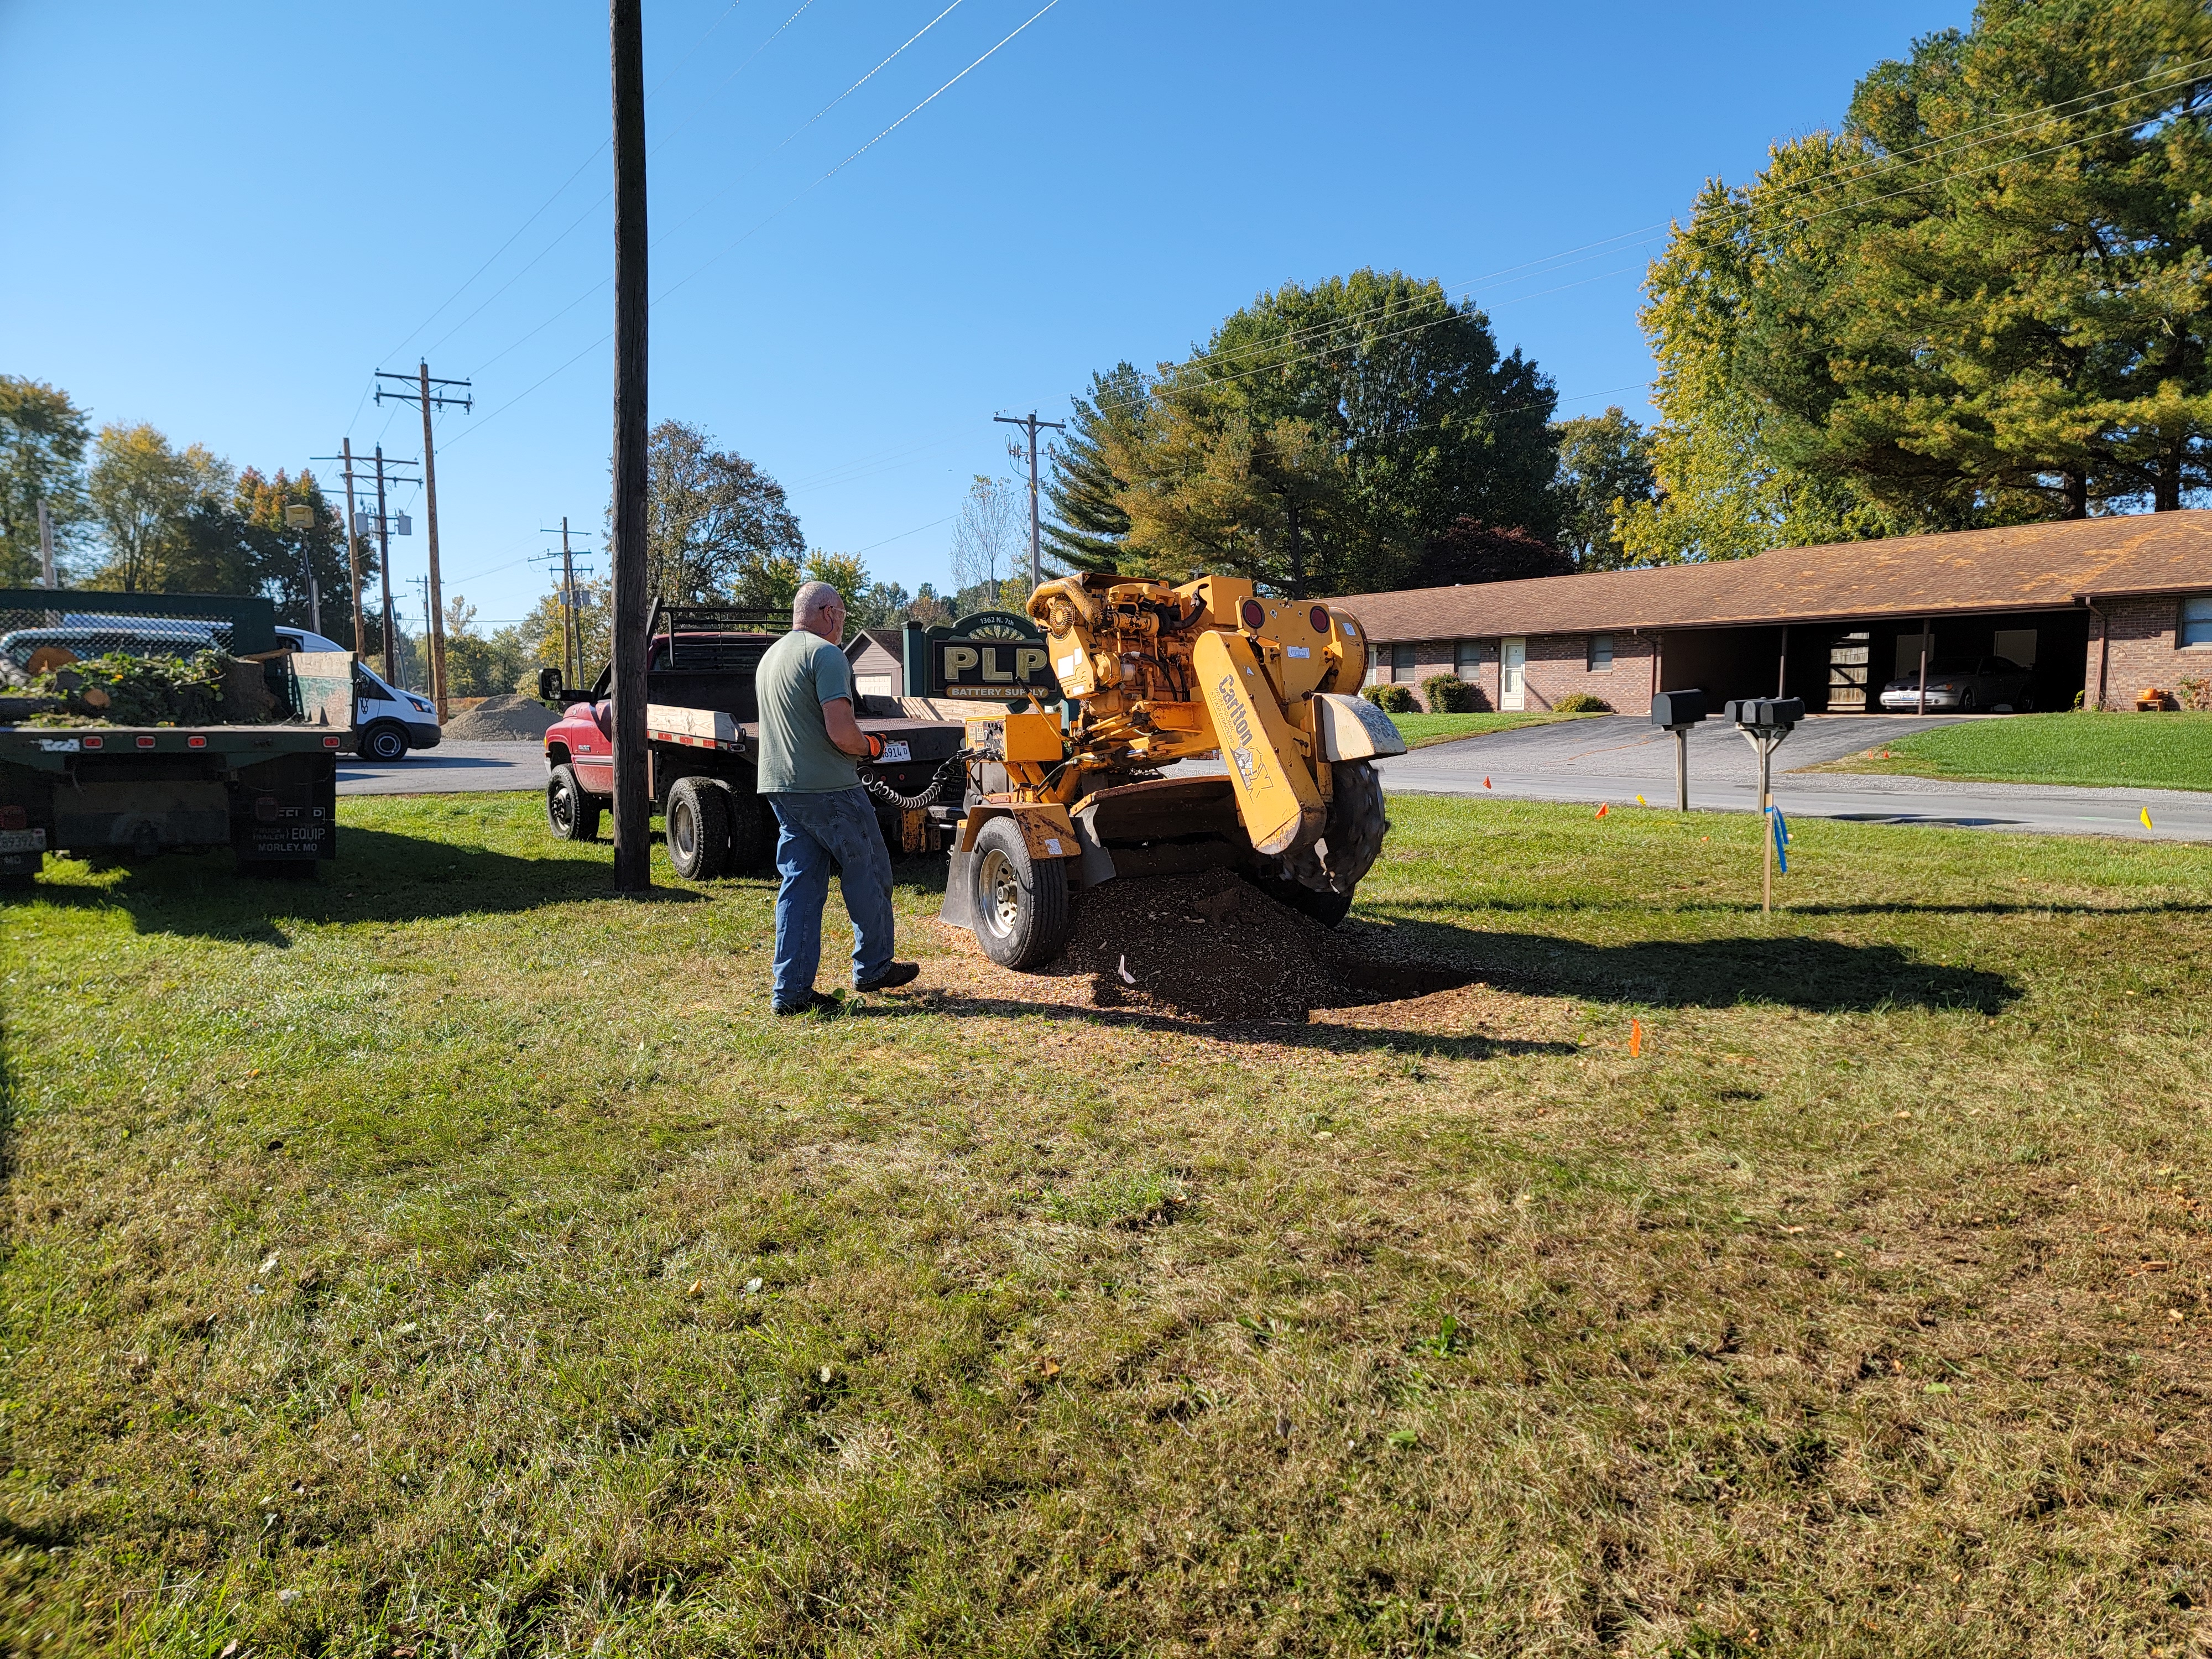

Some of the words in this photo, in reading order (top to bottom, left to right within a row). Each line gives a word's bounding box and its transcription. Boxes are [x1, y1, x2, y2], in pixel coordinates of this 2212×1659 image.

[1005, 618, 1014, 626] 7th
[944, 646, 1048, 682] PLP
[952, 688, 1002, 696] BATTERY
[1214, 687, 1235, 733] PROFESSIONAL
[1211, 691, 1222, 711] STUMP
[1219, 713, 1234, 744] GRINDERS
[1219, 674, 1253, 747] Carlton
[291, 828, 326, 841] EQUIP.
